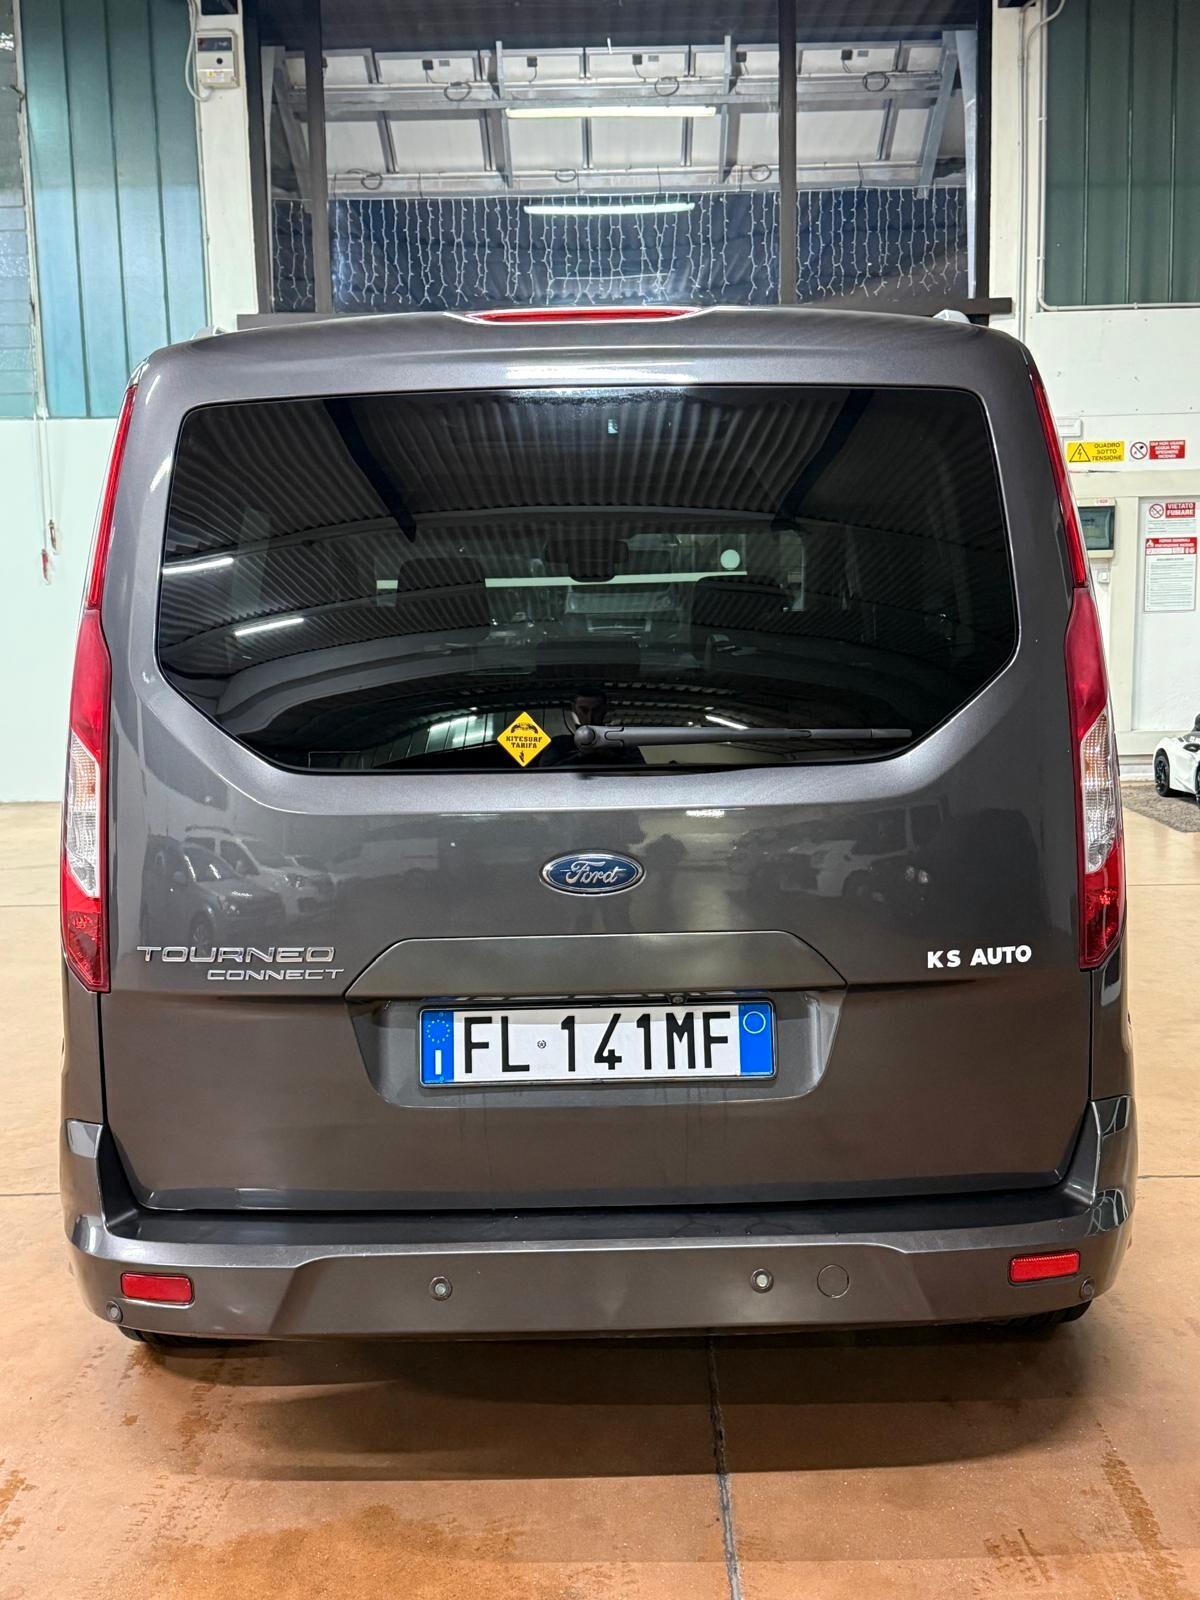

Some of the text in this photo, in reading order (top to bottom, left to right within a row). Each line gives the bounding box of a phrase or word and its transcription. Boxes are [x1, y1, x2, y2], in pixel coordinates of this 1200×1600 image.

[560, 860, 626, 884] Ford
[136, 946, 336, 963] TOURNEO
[969, 945, 1032, 966] AUTO
[207, 968, 345, 981] CONNECT
